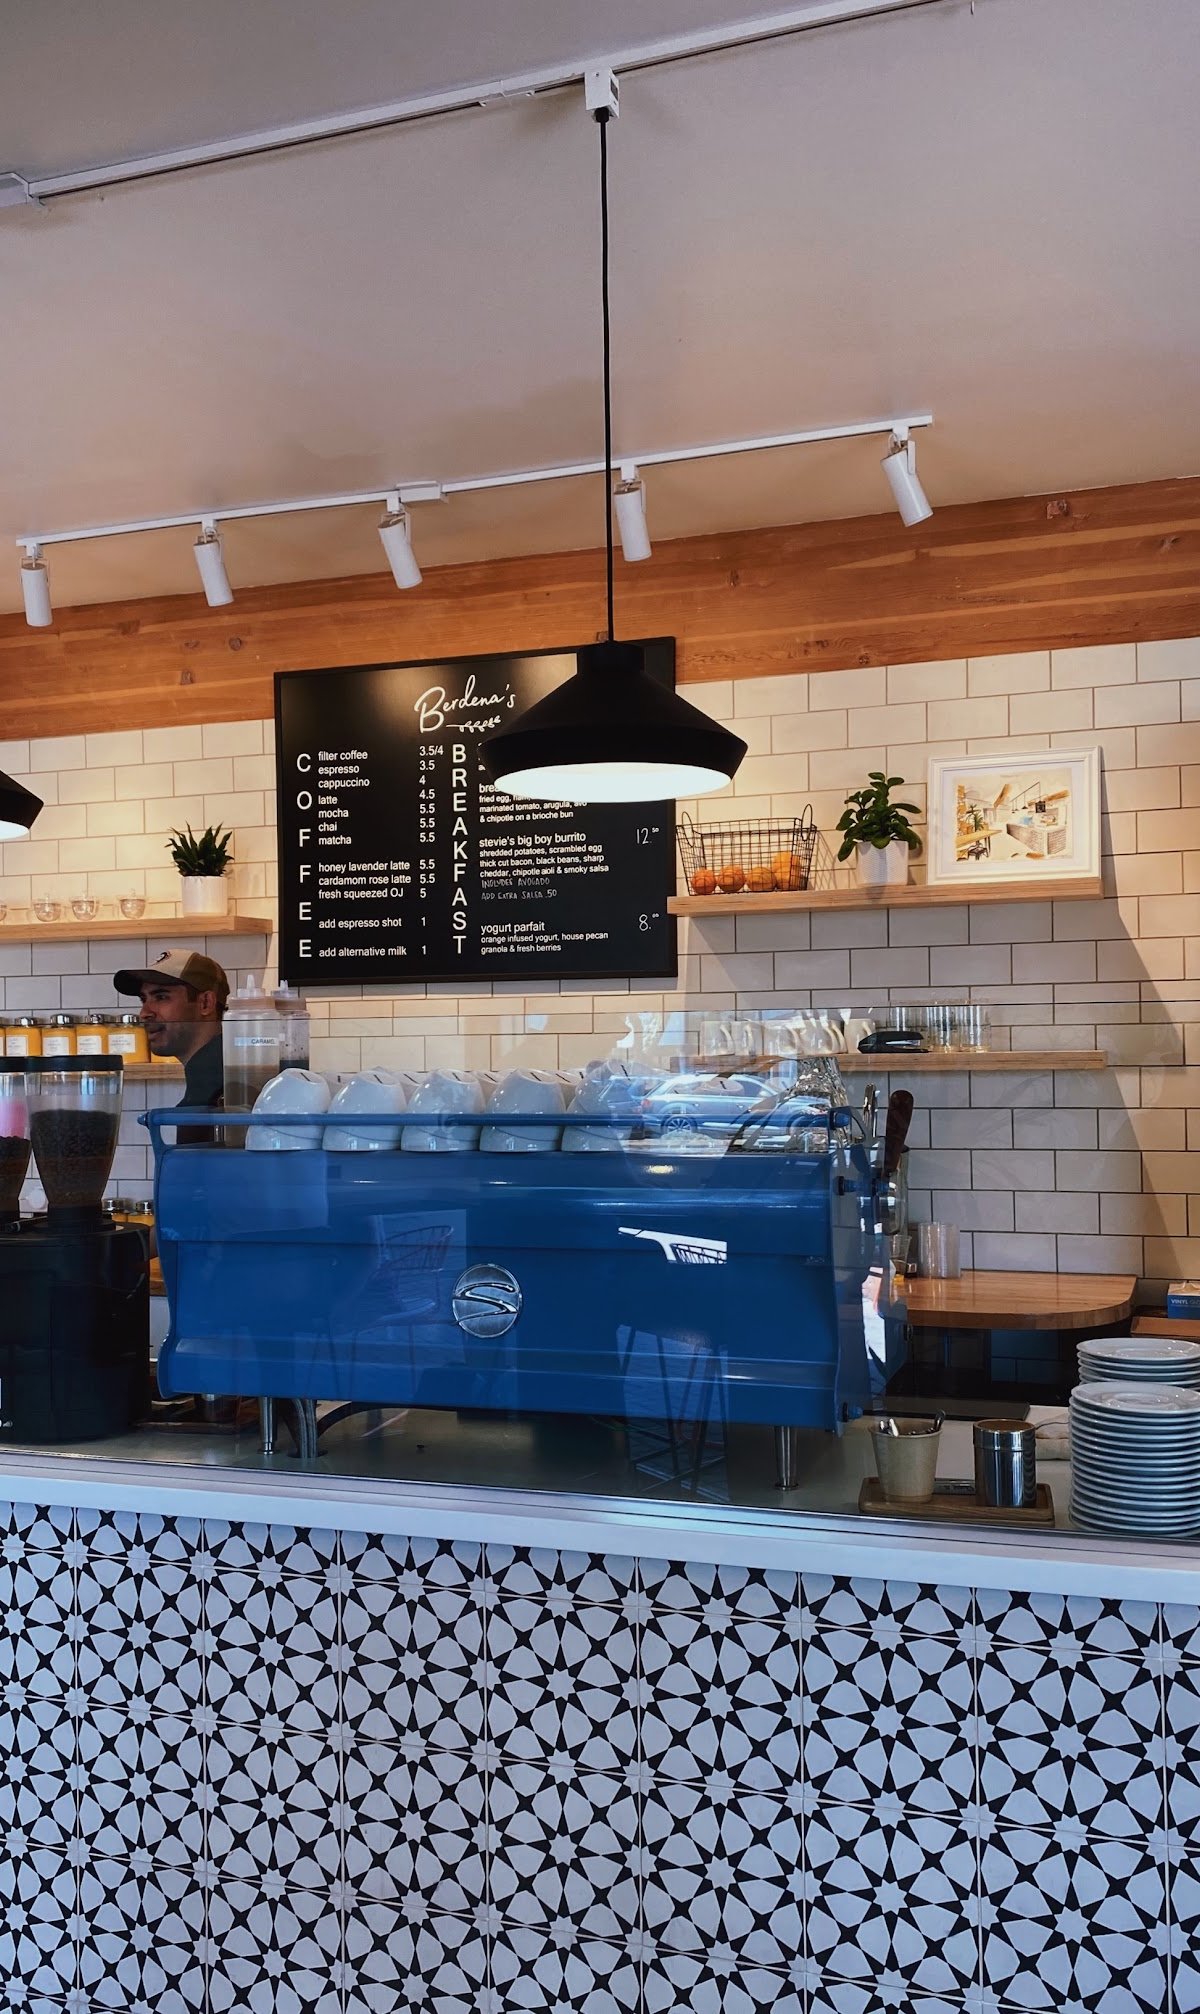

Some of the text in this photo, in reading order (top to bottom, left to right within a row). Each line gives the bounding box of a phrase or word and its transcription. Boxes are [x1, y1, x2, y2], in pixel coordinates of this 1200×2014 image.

[414, 675, 516, 733] Berdena's
[318, 750, 368, 761] filter coffee
[419, 746, 444, 756] 3.5/4
[419, 760, 435, 770] 3.5
[318, 765, 360, 776] espresso
[318, 778, 370, 789] cappuccino
[419, 775, 426, 784] 4
[419, 789, 435, 799] 4.5
[479, 795, 495, 803] fried
[318, 795, 338, 804] latte
[420, 804, 435, 813] 5.5
[479, 803, 514, 813] marinated
[515, 803, 542, 811] tomato,
[543, 801, 572, 810] arugula,
[318, 809, 349, 818] mocha
[480, 815, 485, 823] &
[486, 814, 514, 823] chipotle
[318, 822, 337, 832] chai
[420, 818, 435, 828] 5.5
[318, 835, 352, 846] matcha
[420, 832, 435, 843] 5.5
[479, 832, 586, 847] stevie's big boy burrito
[479, 844, 602, 857] shredded potatoes, scrambled egg
[420, 859, 435, 869] 5.5
[479, 859, 496, 867] thick
[510, 858, 534, 866] bacon,
[536, 856, 555, 865] black
[557, 856, 581, 864] beans,
[583, 854, 604, 863] sharp
[318, 861, 410, 874] honey lavender latte
[479, 864, 609, 878] cheddar, chipotle aioli & smoky salsa
[318, 875, 411, 885] cardamom rose latte
[420, 874, 436, 883] 5.5
[318, 888, 404, 900] fresh squeezed OJ
[420, 888, 426, 898] 5
[481, 892, 495, 900] ADD
[319, 918, 402, 930] add espresso shot
[421, 917, 426, 926] 1
[481, 921, 545, 935] yogurt parfait
[481, 935, 506, 944] orange
[507, 934, 533, 942] infused
[535, 934, 560, 943] yogurt,
[585, 932, 608, 941] pecan
[319, 946, 407, 957] add alternative milk
[422, 945, 426, 954] 1
[481, 946, 508, 955] granola
[517, 944, 534, 952] fresh
[536, 944, 561, 952] berries
